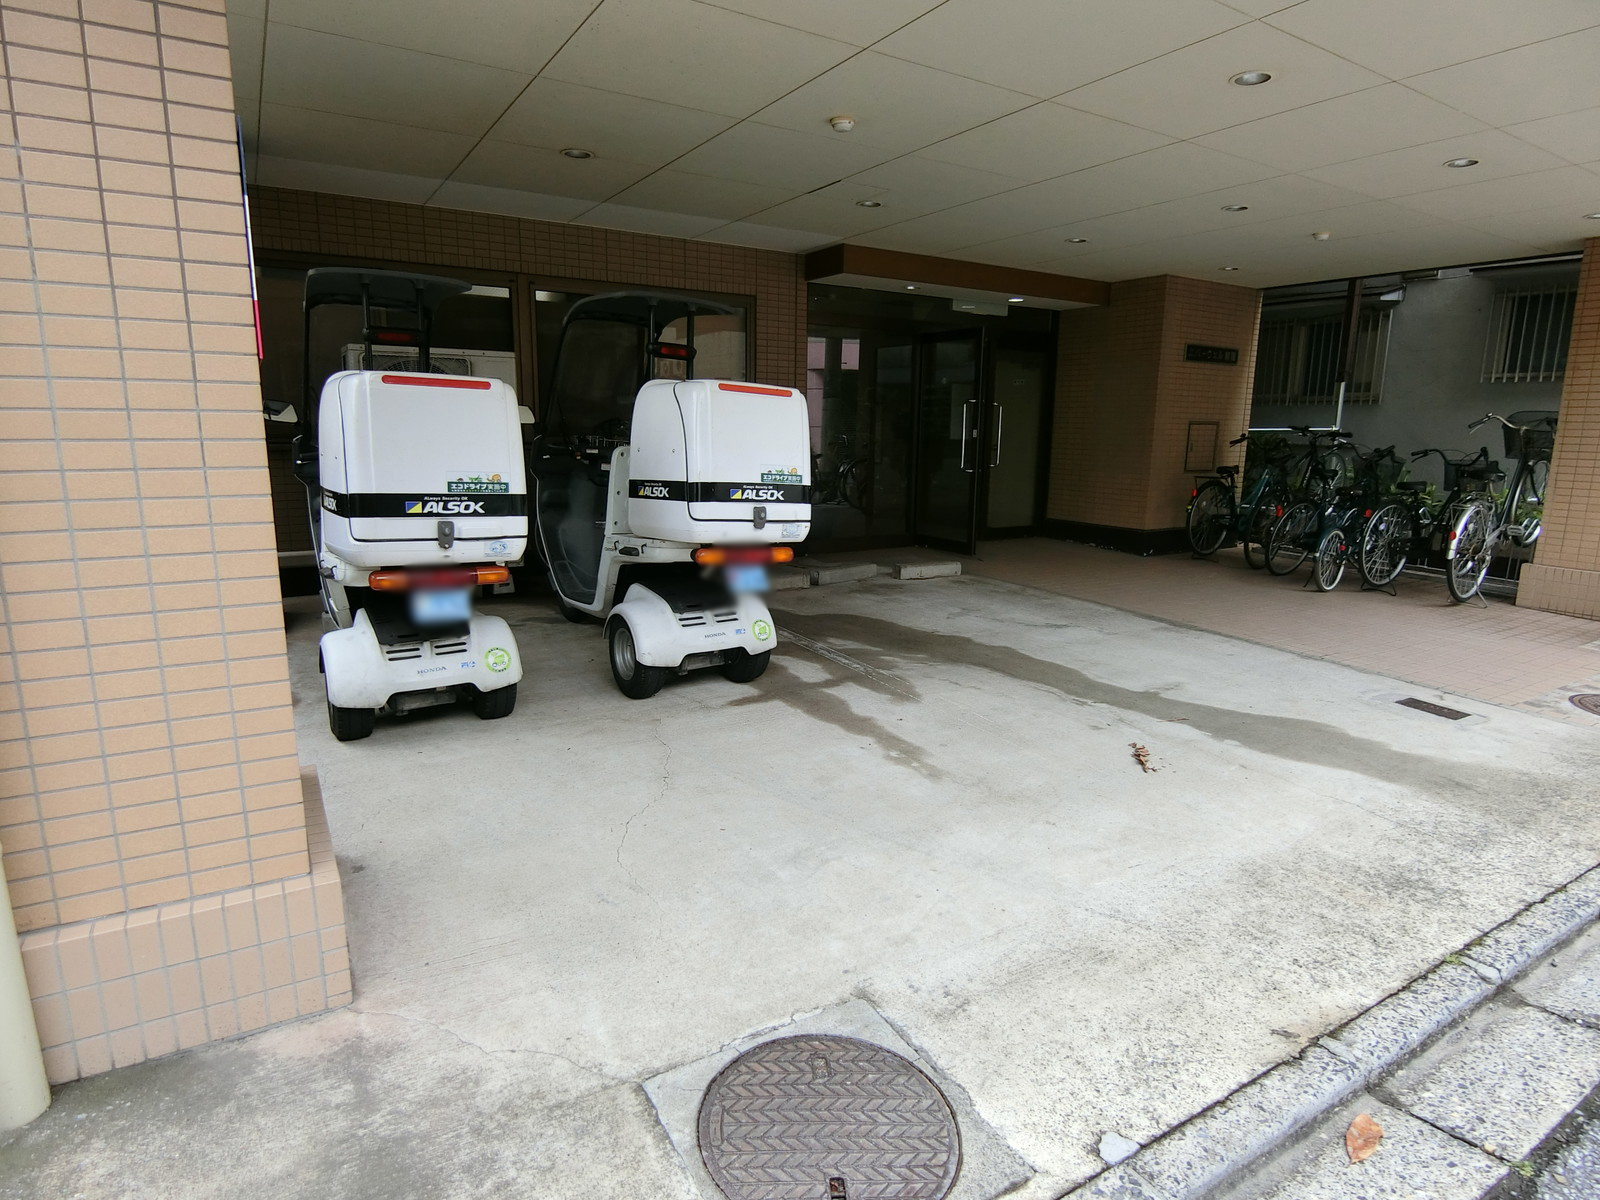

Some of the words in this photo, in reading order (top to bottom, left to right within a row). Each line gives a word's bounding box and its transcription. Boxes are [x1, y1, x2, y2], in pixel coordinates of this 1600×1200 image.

[644, 486, 669, 498] ALSOK
[742, 489, 785, 501] ALSOK
[422, 501, 486, 514] ALSOK
[417, 666, 447, 675] HONDA
